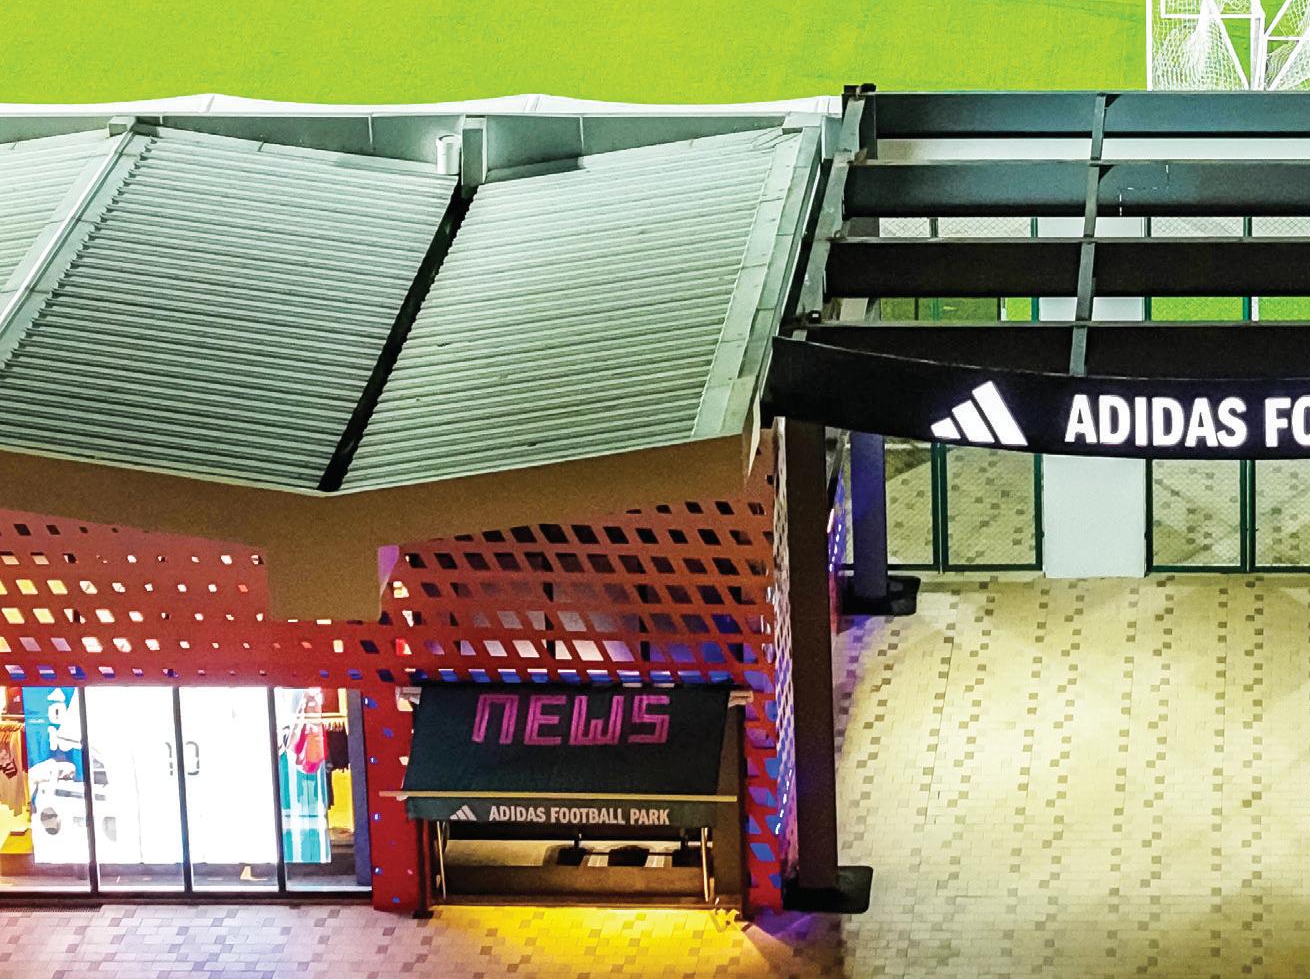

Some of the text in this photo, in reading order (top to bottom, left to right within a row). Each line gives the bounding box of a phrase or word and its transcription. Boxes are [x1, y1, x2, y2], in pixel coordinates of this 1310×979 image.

[1064, 394, 1247, 447] ADIDAS
[471, 694, 671, 746] NEWS
[489, 805, 670, 825] ADIDAS FOOTBALL PARK
